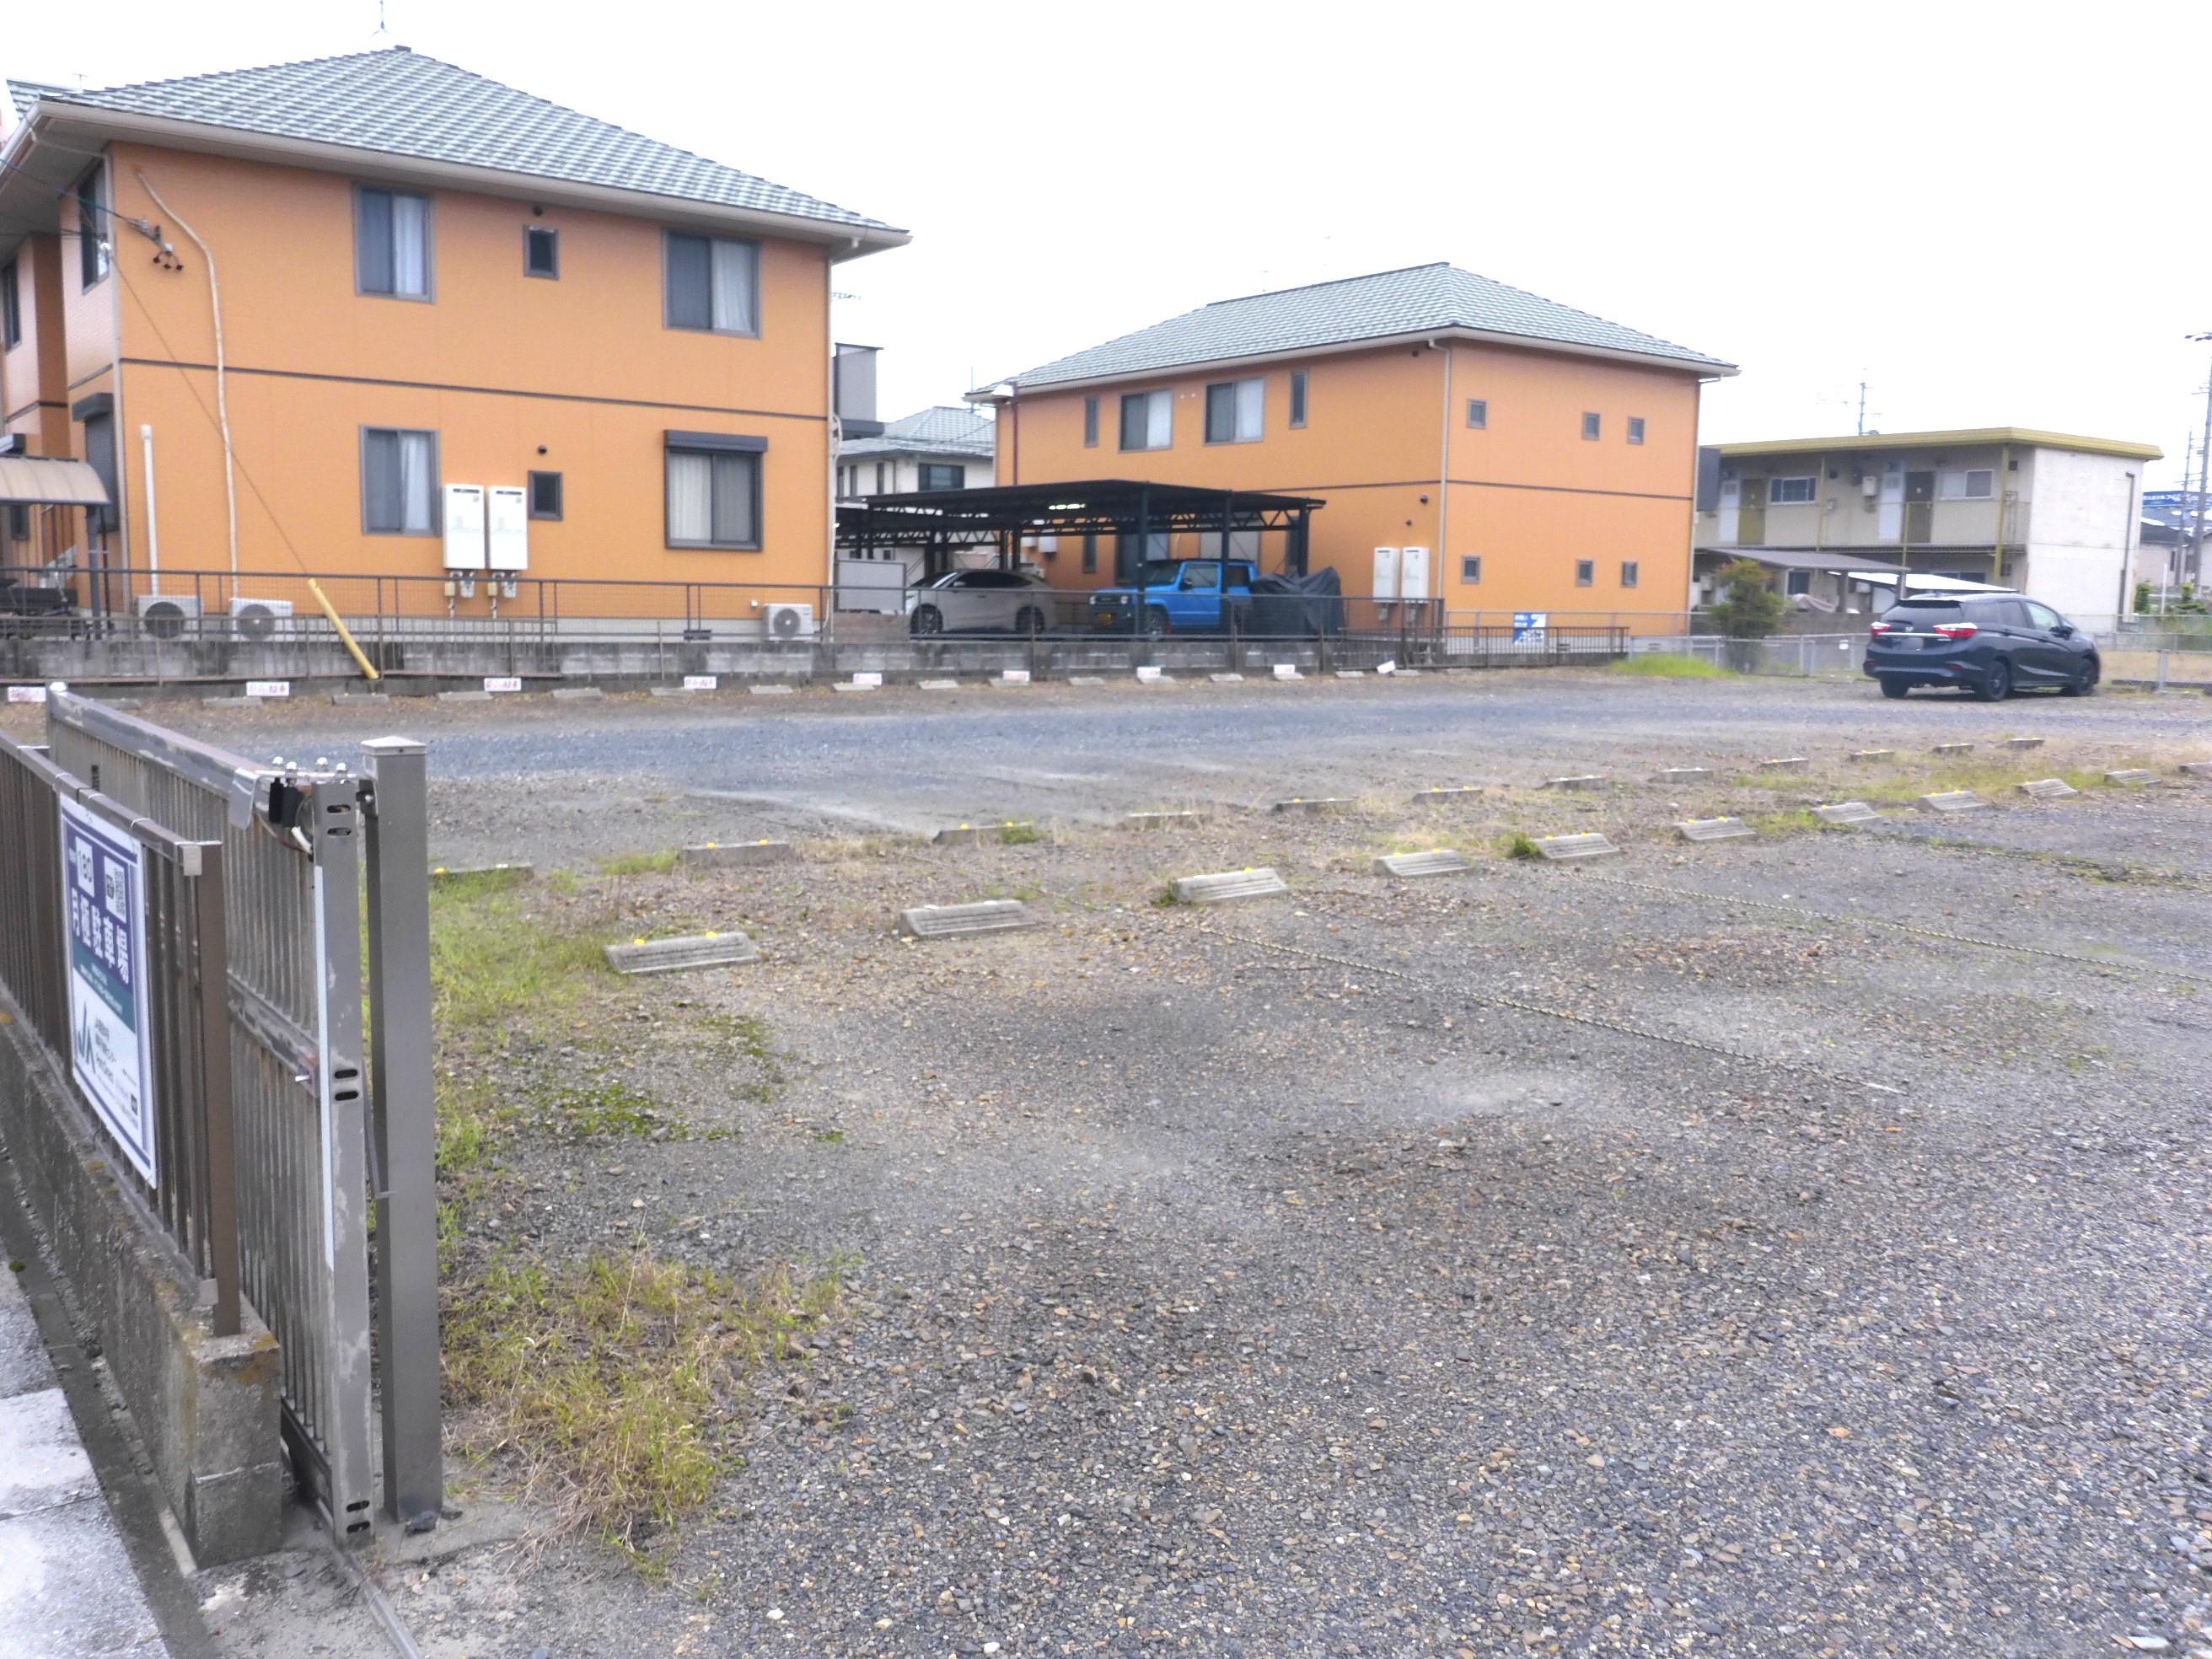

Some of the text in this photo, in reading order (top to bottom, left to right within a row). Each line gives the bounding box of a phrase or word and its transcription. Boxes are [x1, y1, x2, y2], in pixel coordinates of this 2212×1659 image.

[72, 887, 129, 985] 月極駐車場
